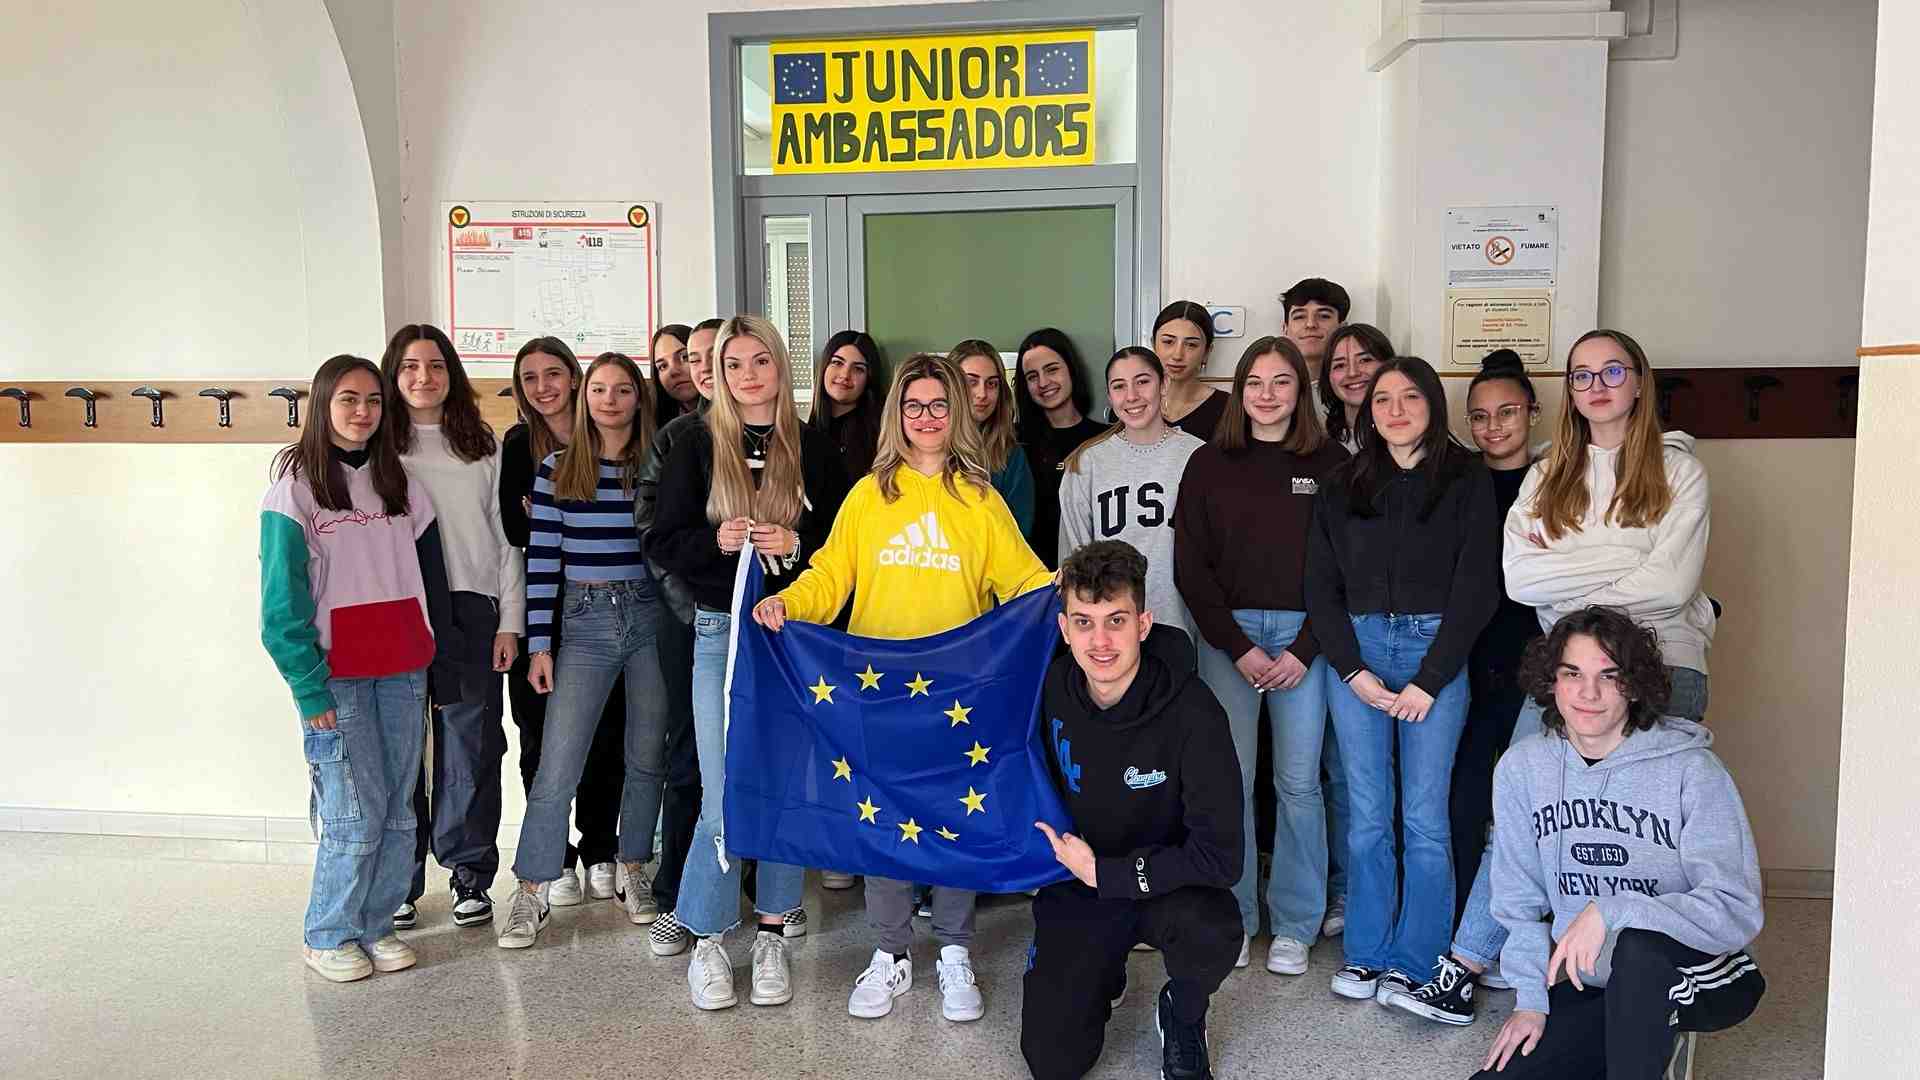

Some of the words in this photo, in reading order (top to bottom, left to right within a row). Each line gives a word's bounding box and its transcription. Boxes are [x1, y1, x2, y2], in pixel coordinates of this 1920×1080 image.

[831, 45, 1020, 104] JUNIOR
[777, 103, 1091, 165] AMBASSADORS
[553, 210, 587, 218] SICUREZZA
[1292, 477, 1316, 485] NASA
[1098, 482, 1175, 537] US
[879, 544, 961, 572] adidas
[1532, 798, 1677, 850] BROOKLYN
[1575, 846, 1599, 862] EST.
[1601, 848, 1624, 864] 1631
[1554, 872, 1600, 897] NEW
[1604, 876, 1661, 898] YORK
